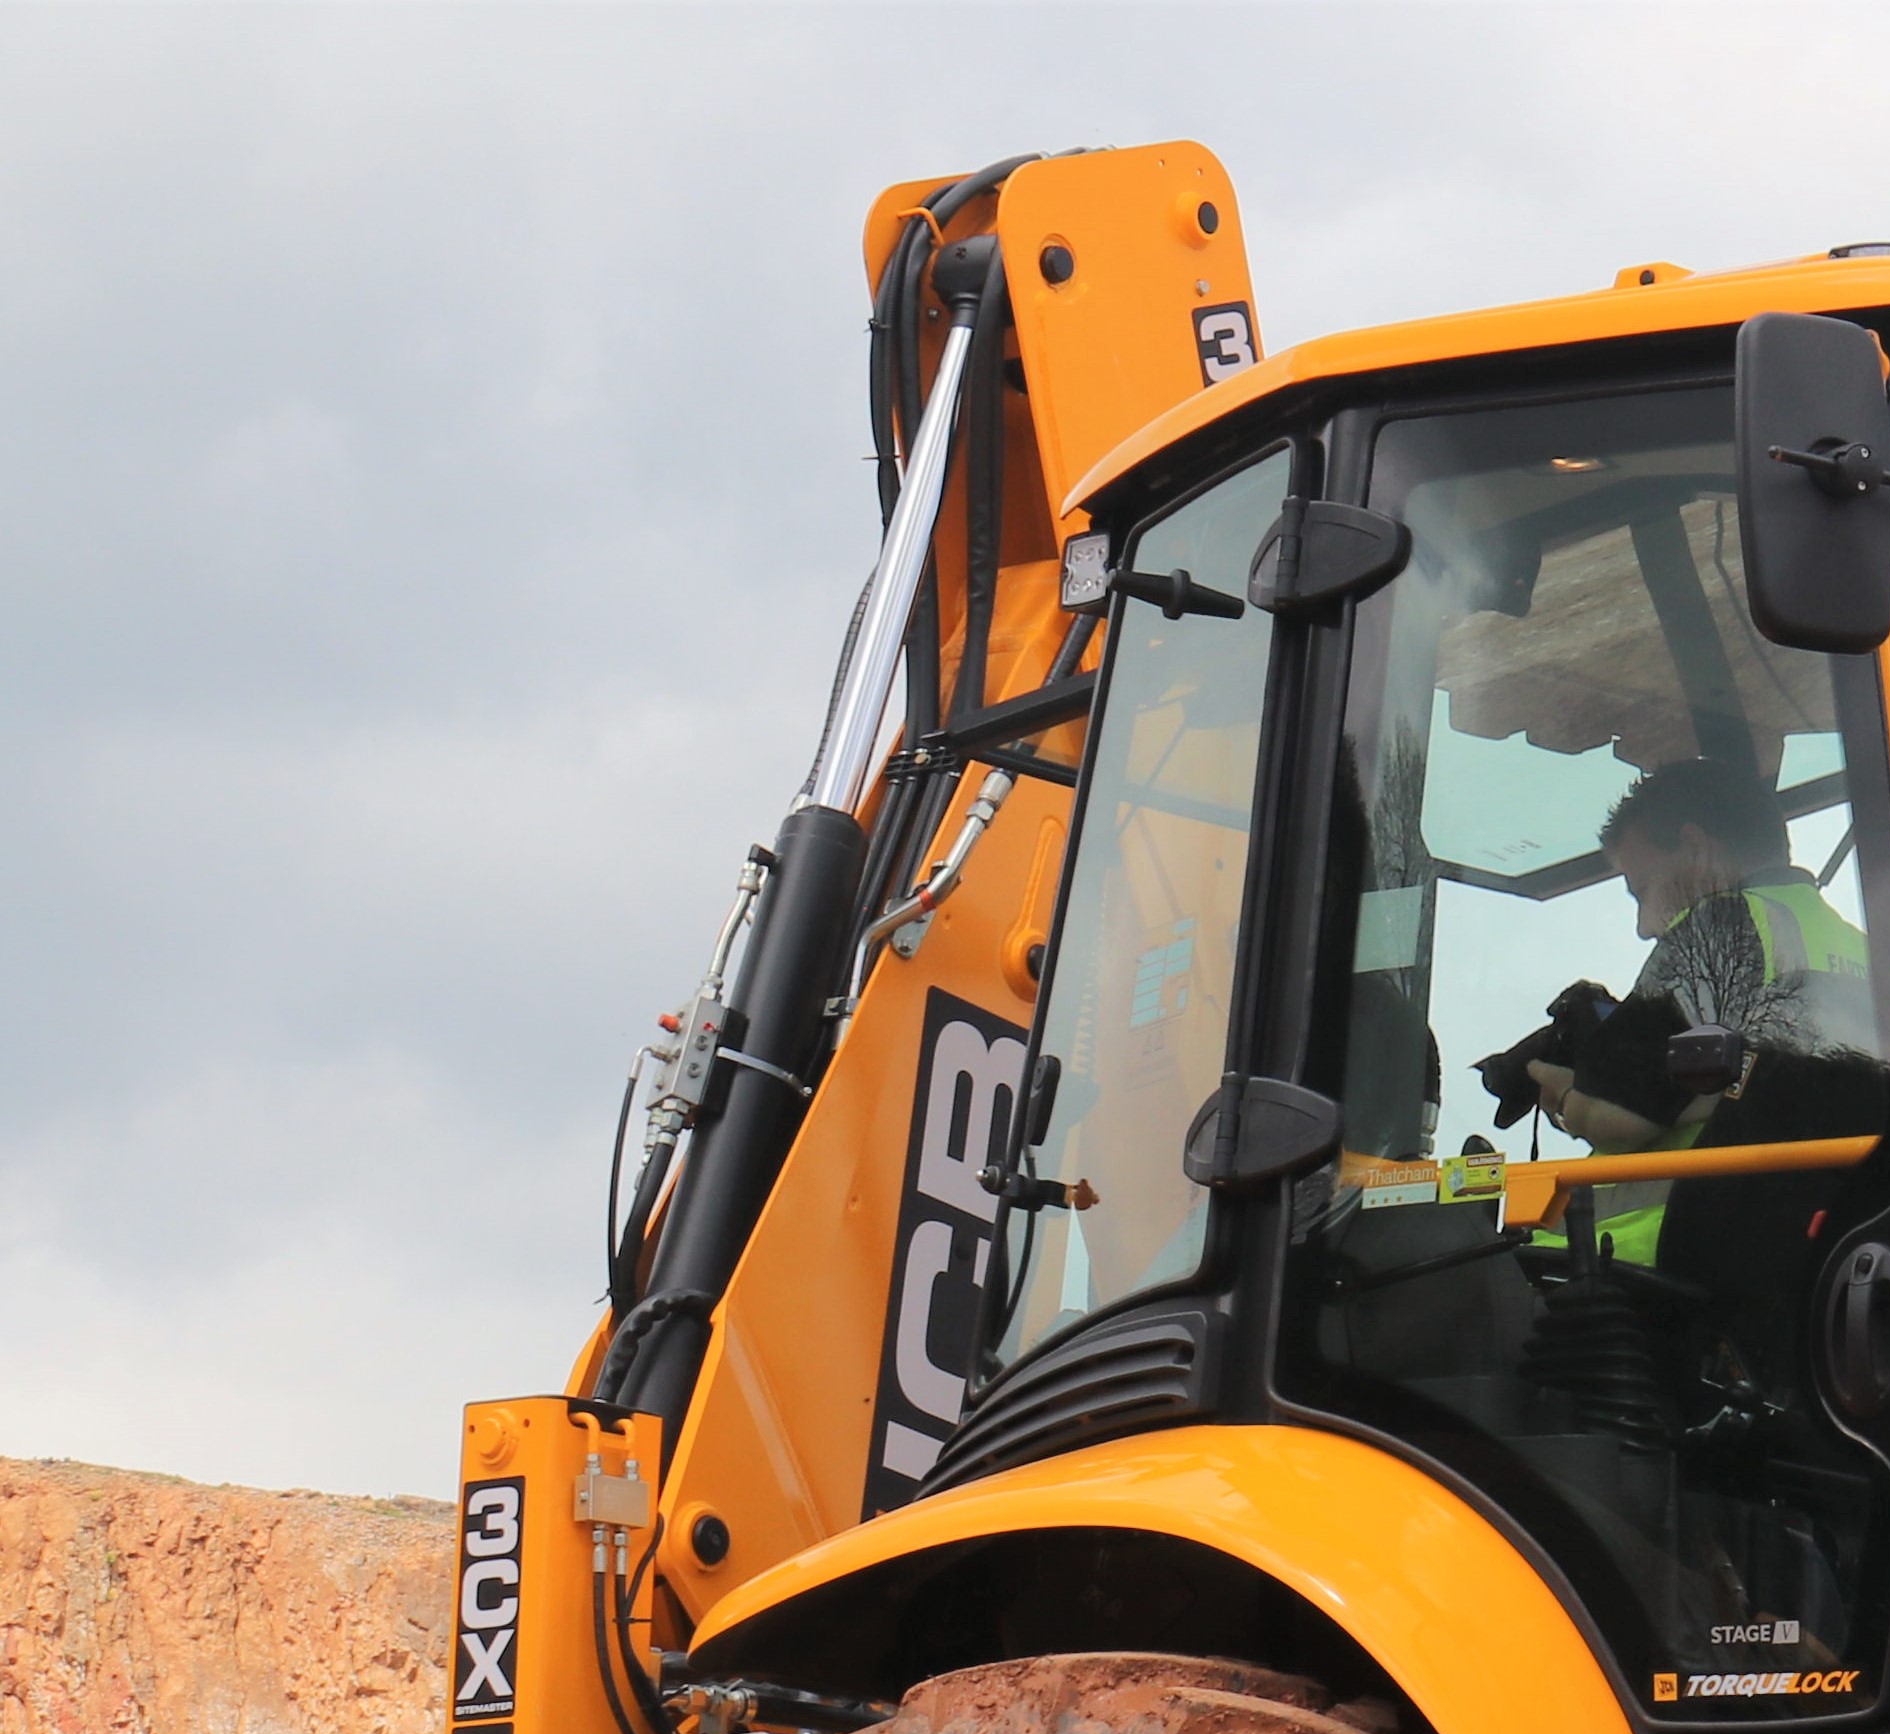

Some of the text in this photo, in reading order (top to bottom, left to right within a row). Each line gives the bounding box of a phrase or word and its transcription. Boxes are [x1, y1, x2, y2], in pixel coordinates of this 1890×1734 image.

[1200, 311, 1254, 382] 3
[1368, 1166, 1435, 1186] Thatcham
[456, 1486, 519, 1701] 3CX
[1711, 1624, 1771, 1644] STAGE
[1685, 1671, 1860, 1697] TORQUELOCK
